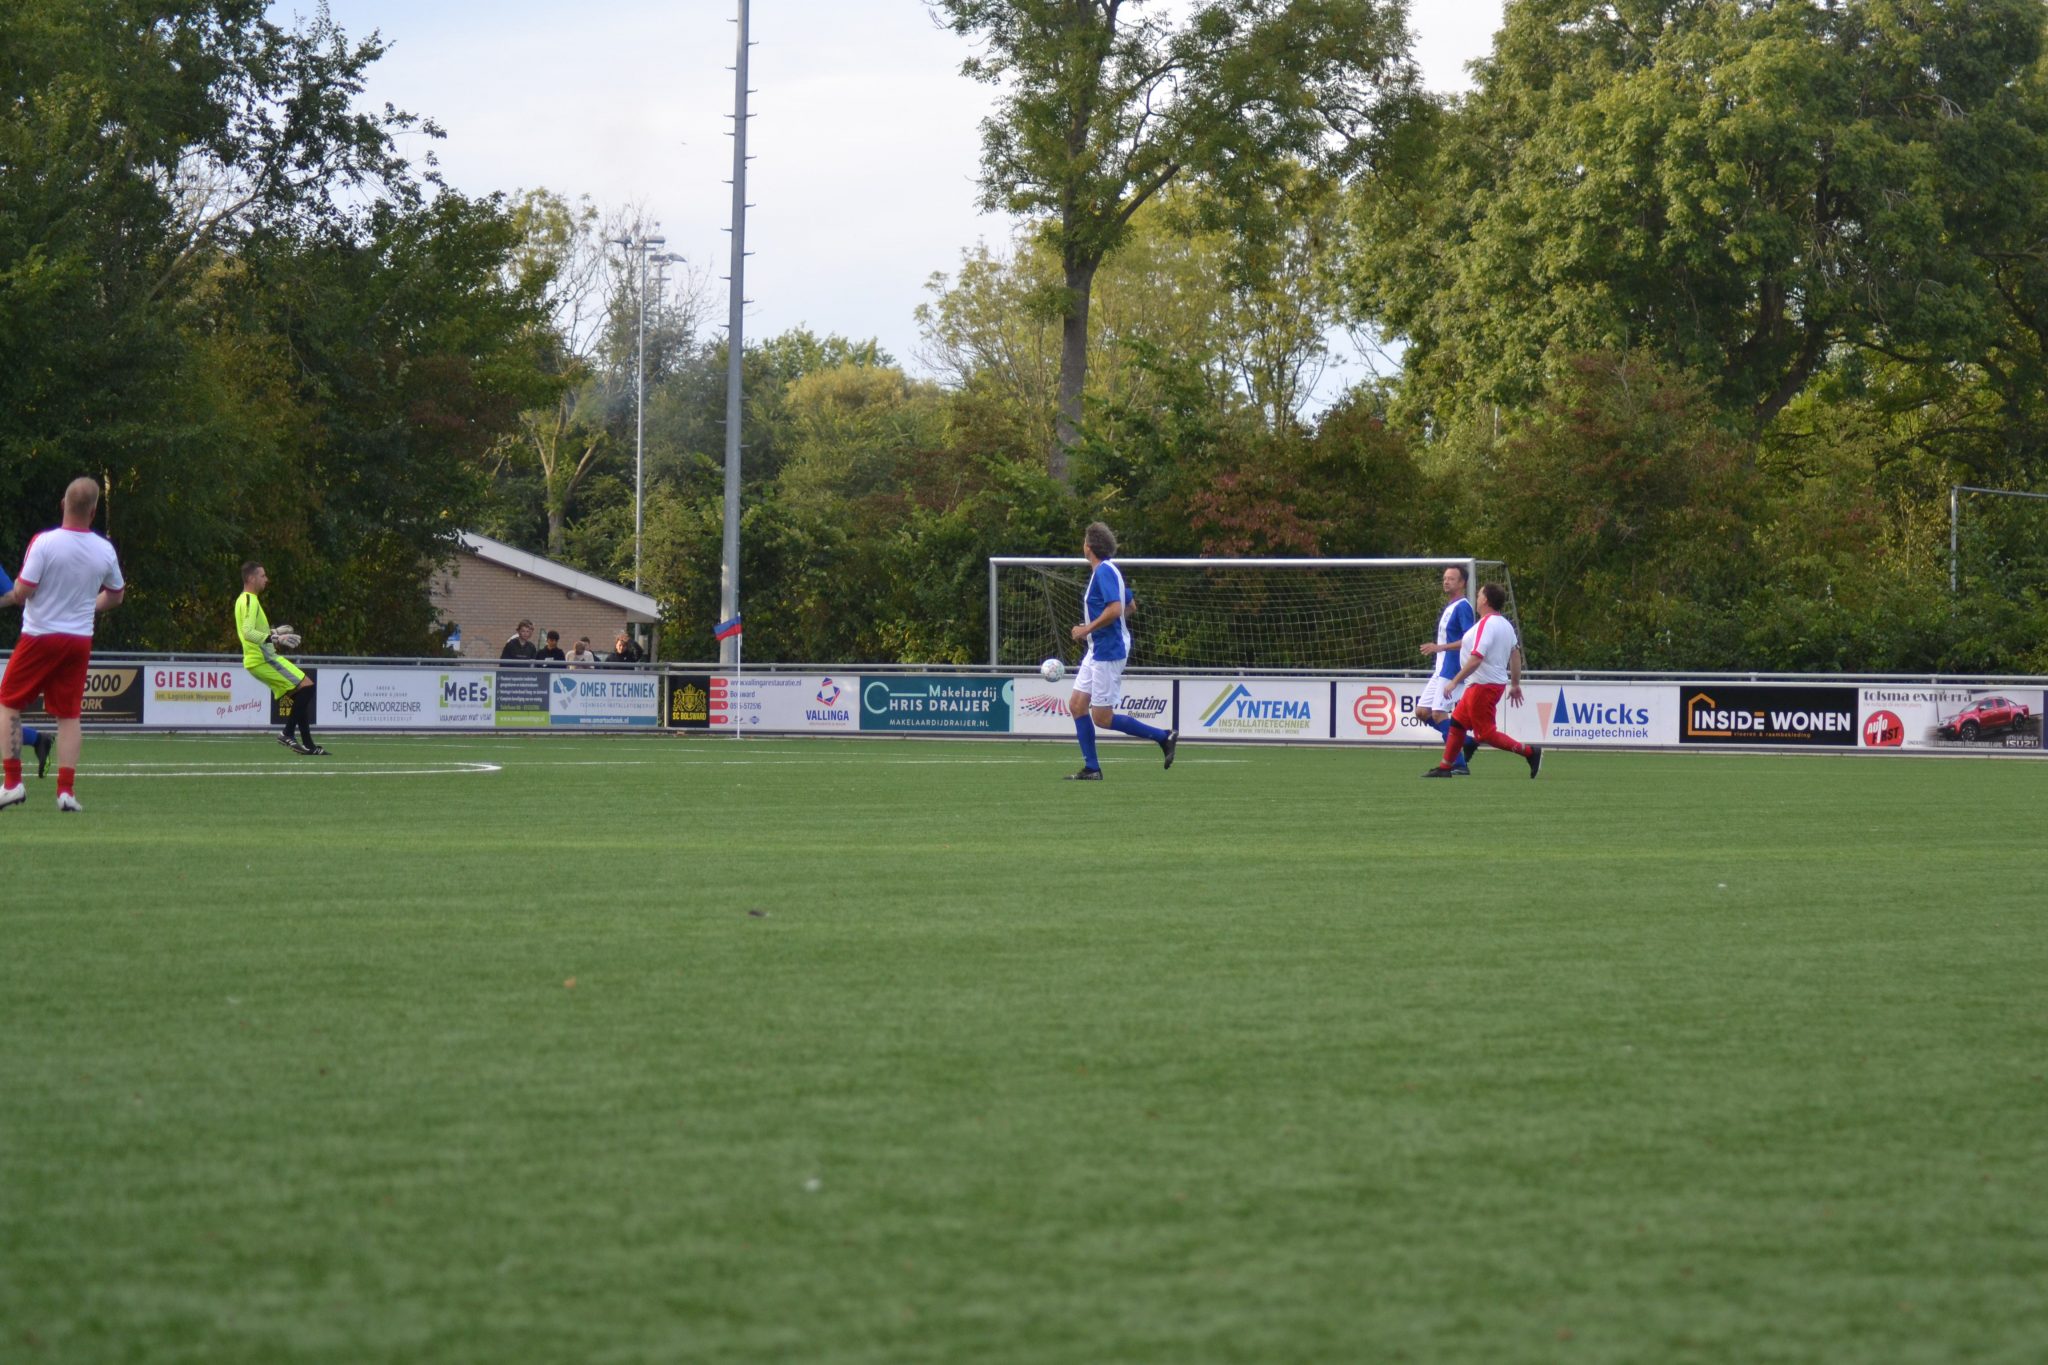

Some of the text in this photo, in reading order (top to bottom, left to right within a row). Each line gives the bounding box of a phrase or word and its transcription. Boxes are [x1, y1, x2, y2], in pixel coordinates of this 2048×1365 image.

[155, 671, 232, 688] GIESING
[444, 682, 488, 702] MeEs
[580, 682, 655, 698] OMER TECHNIEK
[929, 684, 997, 702] Makelaardij
[1864, 690, 1910, 701] tolsma
[235, 700, 262, 713] overslag
[332, 701, 421, 714] DE GROENVOORZIENER
[929, 700, 990, 712] DRAIJER
[1236, 700, 1311, 719] YNTEMA
[672, 712, 707, 720] SC BOLSWARD
[806, 710, 849, 721] VALLINGA
[1572, 703, 1649, 724] Wicks
[889, 719, 989, 727] MAKELAARDIJDRAIJER.NL
[1218, 719, 1310, 729] INSTALLATIETECHNIEK
[1694, 710, 1851, 731] INSIDE WONEN
[1553, 726, 1649, 739] drainagetechniek
[2006, 740, 2039, 748] ISUZU
